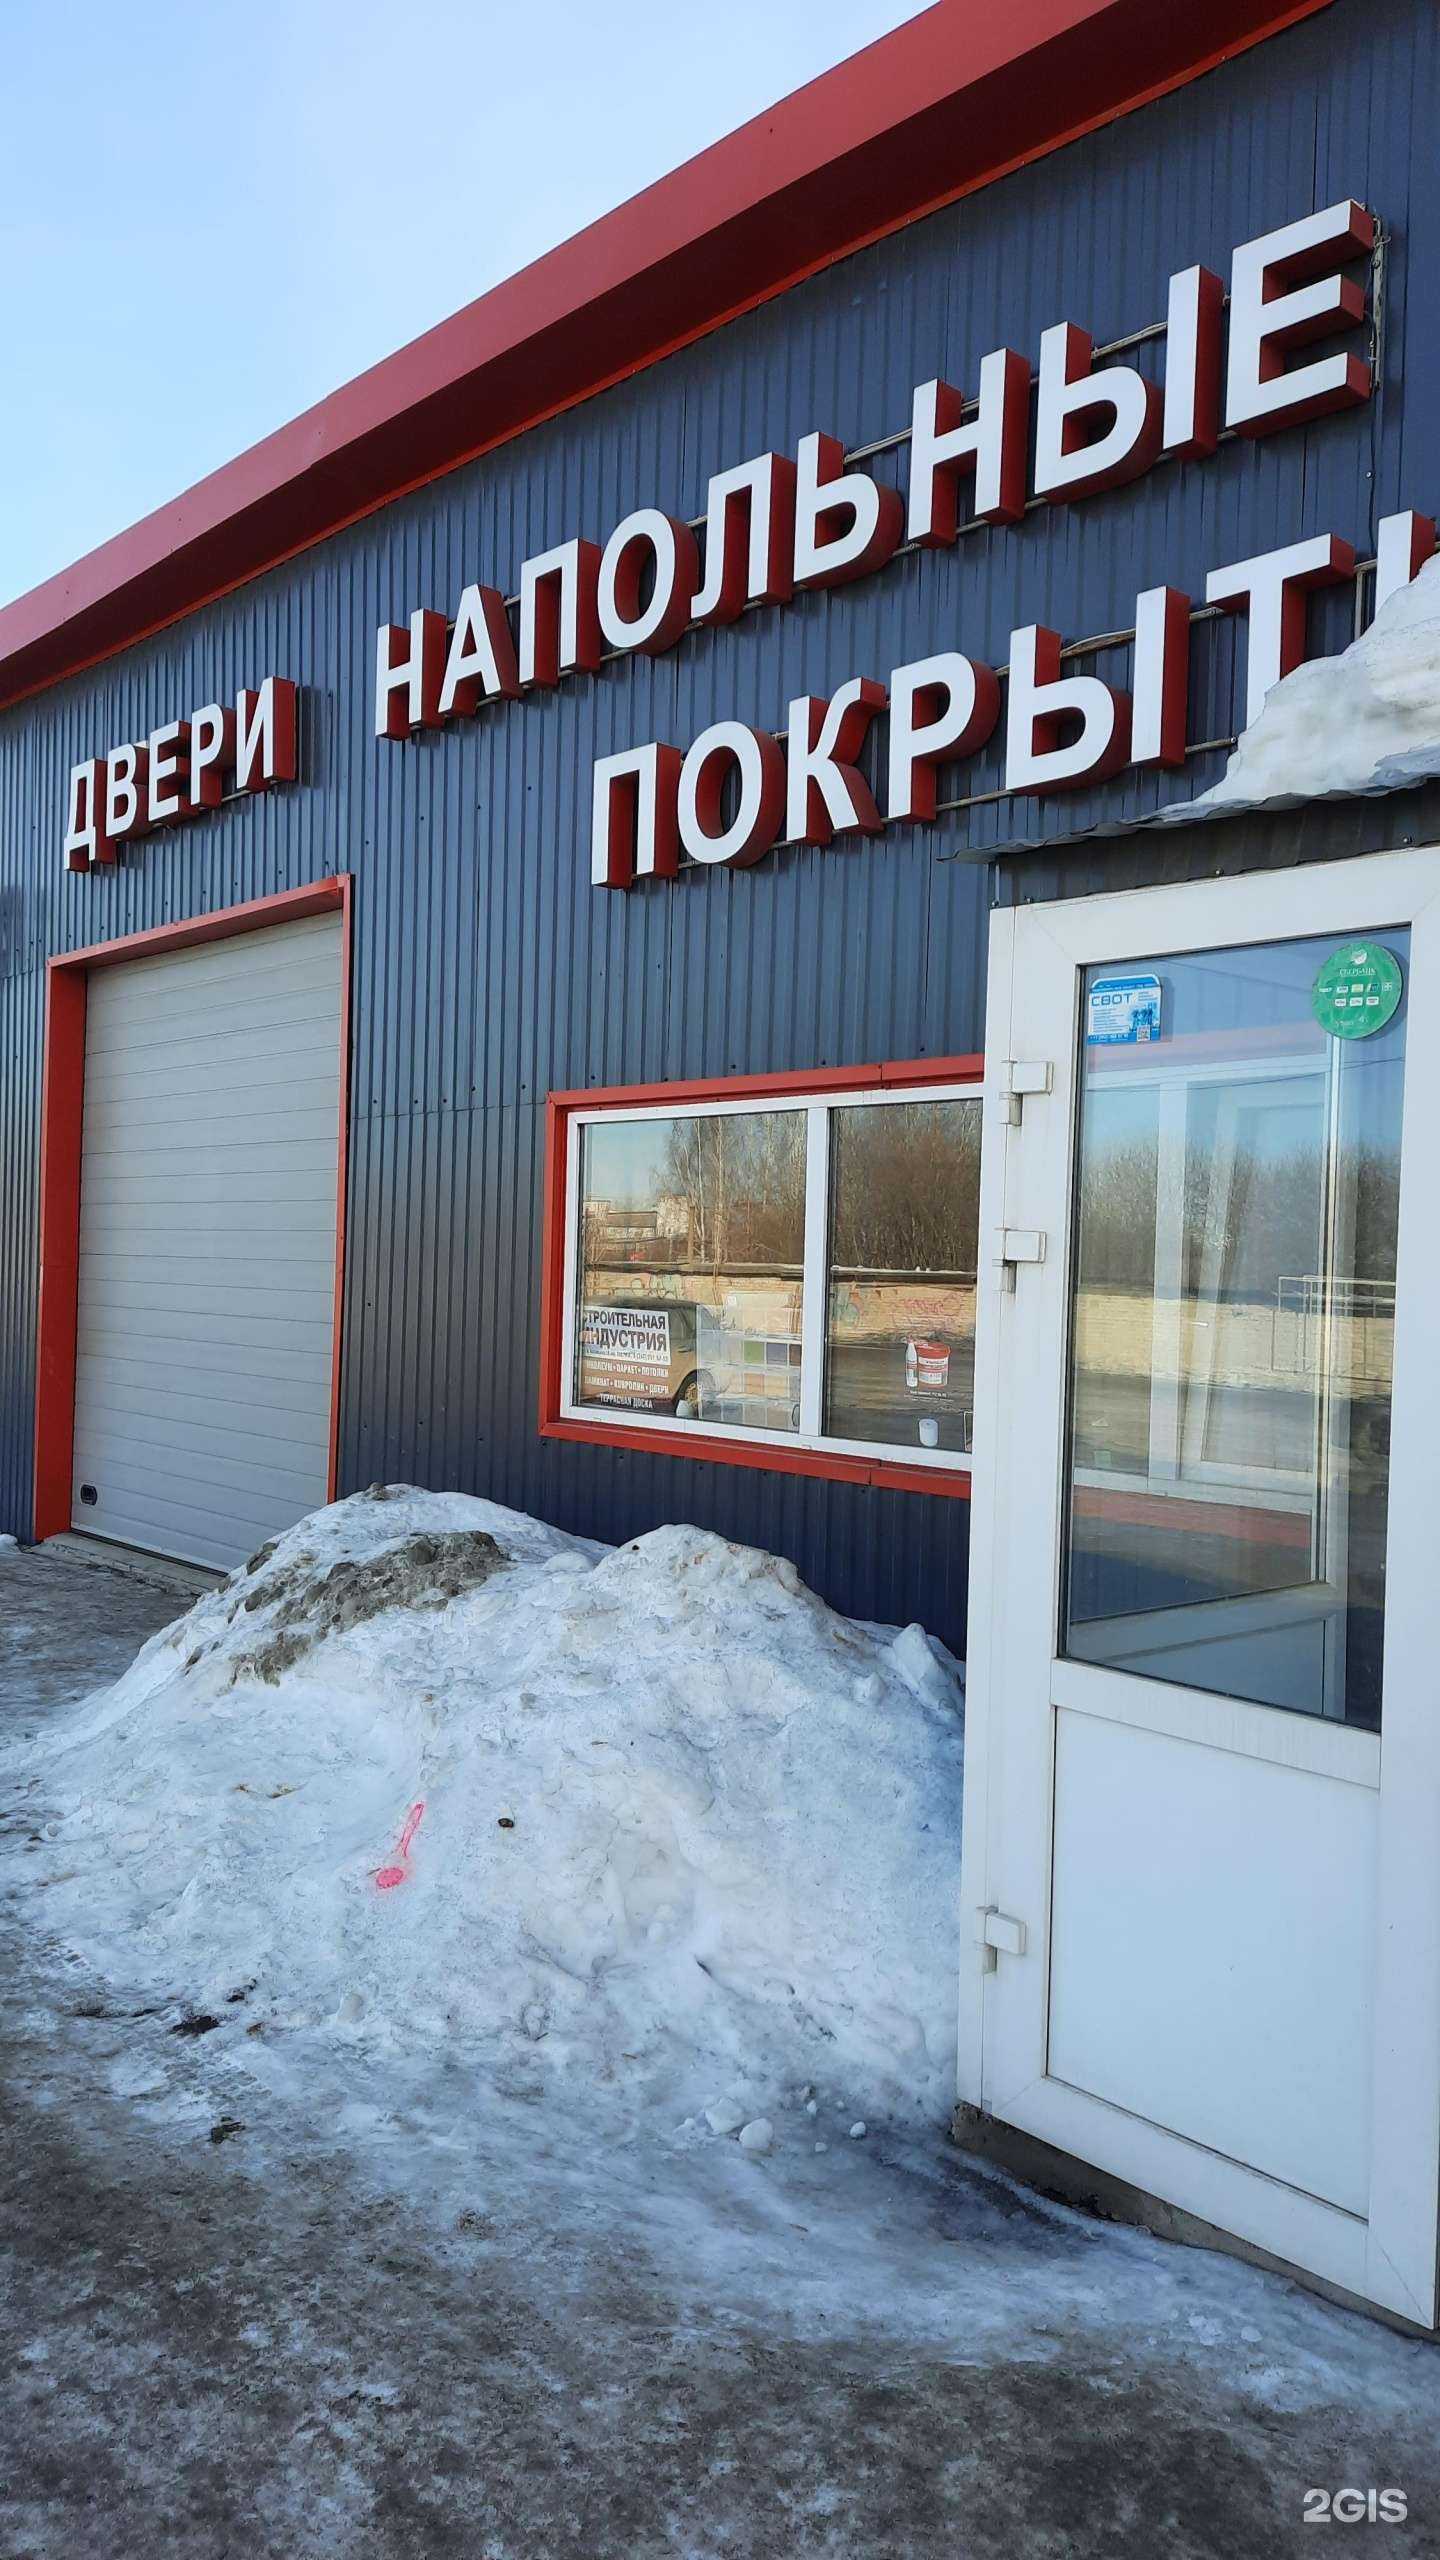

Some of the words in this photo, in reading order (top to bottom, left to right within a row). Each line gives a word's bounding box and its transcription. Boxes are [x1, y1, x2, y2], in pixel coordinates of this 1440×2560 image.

[375, 199, 1372, 741] НАПОЛЬНЫЕ
[63, 676, 297, 873] ДВЕРИ
[582, 1327, 667, 1351] ИНДУСТРИЯ
